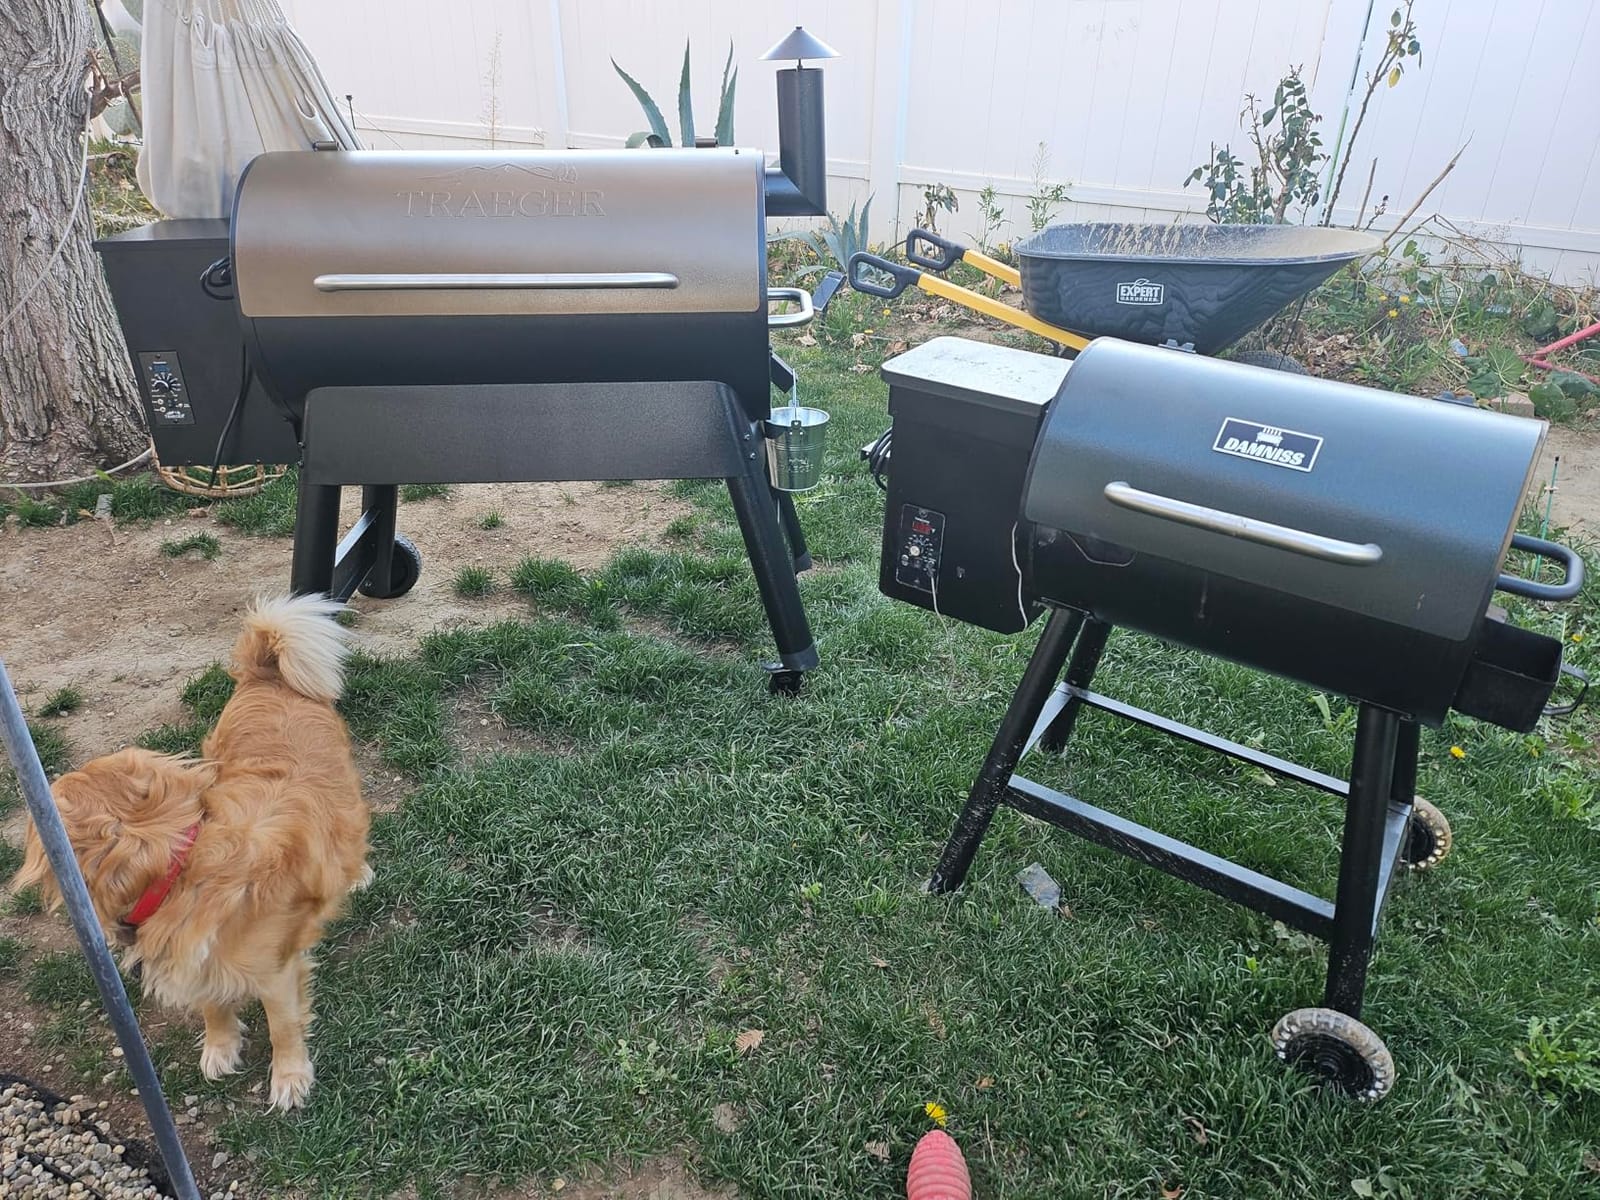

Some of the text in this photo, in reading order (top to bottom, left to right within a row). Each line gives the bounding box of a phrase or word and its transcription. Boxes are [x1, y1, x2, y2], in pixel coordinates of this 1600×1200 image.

[394, 190, 606, 218] TRAEGER
[1120, 285, 1160, 297] EXPERT
[1223, 437, 1306, 466] DAMNISS
